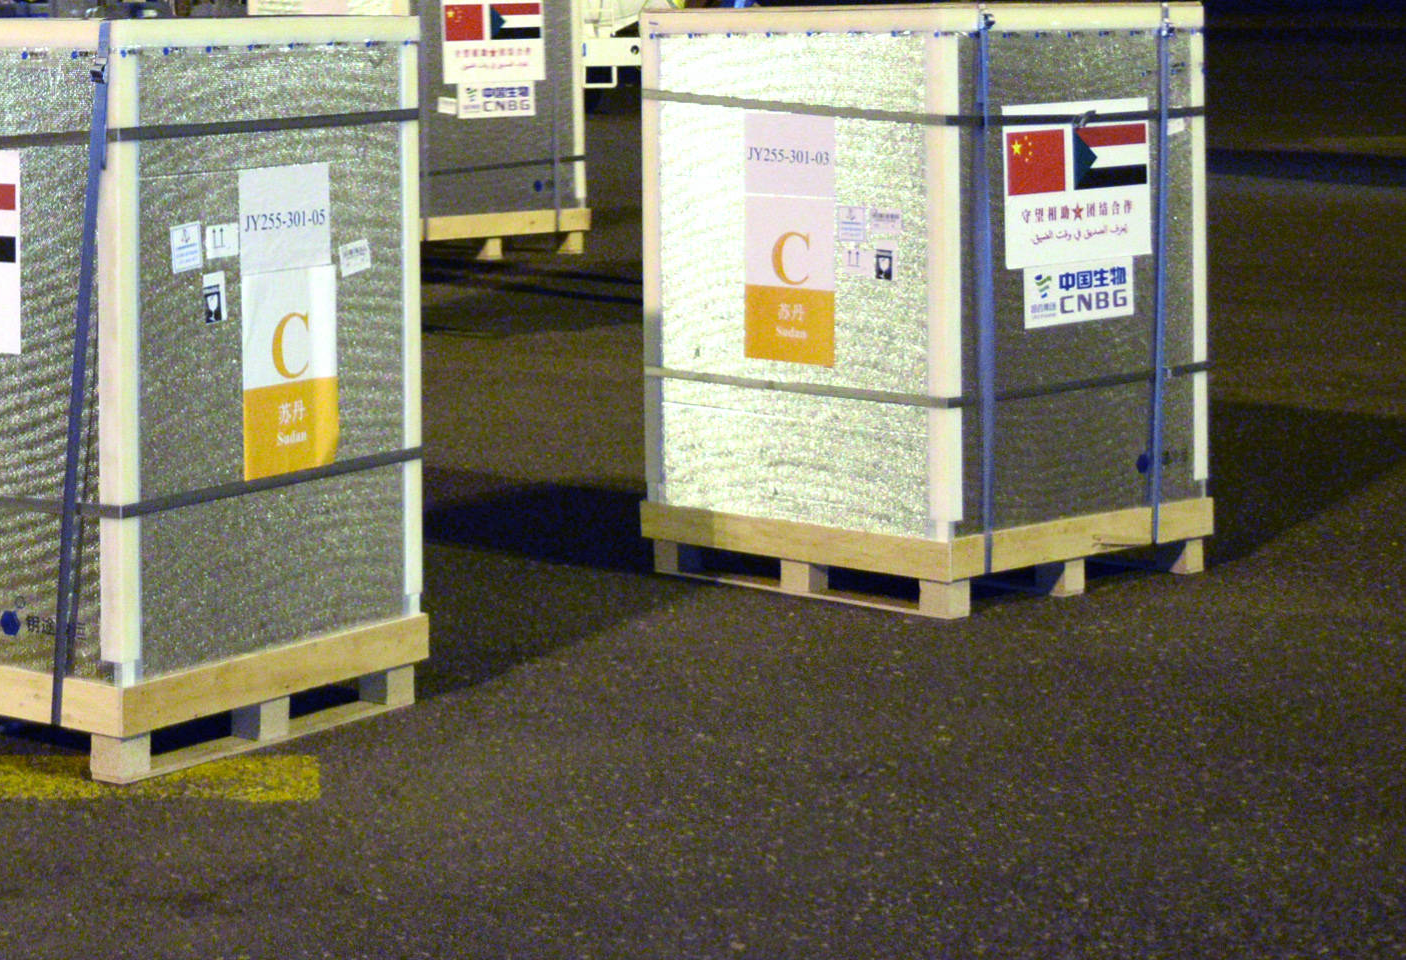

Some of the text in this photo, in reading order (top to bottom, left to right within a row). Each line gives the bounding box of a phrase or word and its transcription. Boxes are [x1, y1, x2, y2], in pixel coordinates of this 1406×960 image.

[483, 100, 530, 112] CNBG
[747, 146, 830, 166] JY255-301-03
[244, 208, 327, 233] JY255-301-05
[771, 231, 811, 286] C
[1059, 266, 1127, 291] 中国生物
[1059, 289, 1128, 314] CNBG
[271, 312, 310, 379] C
[276, 430, 308, 446] Sudan
